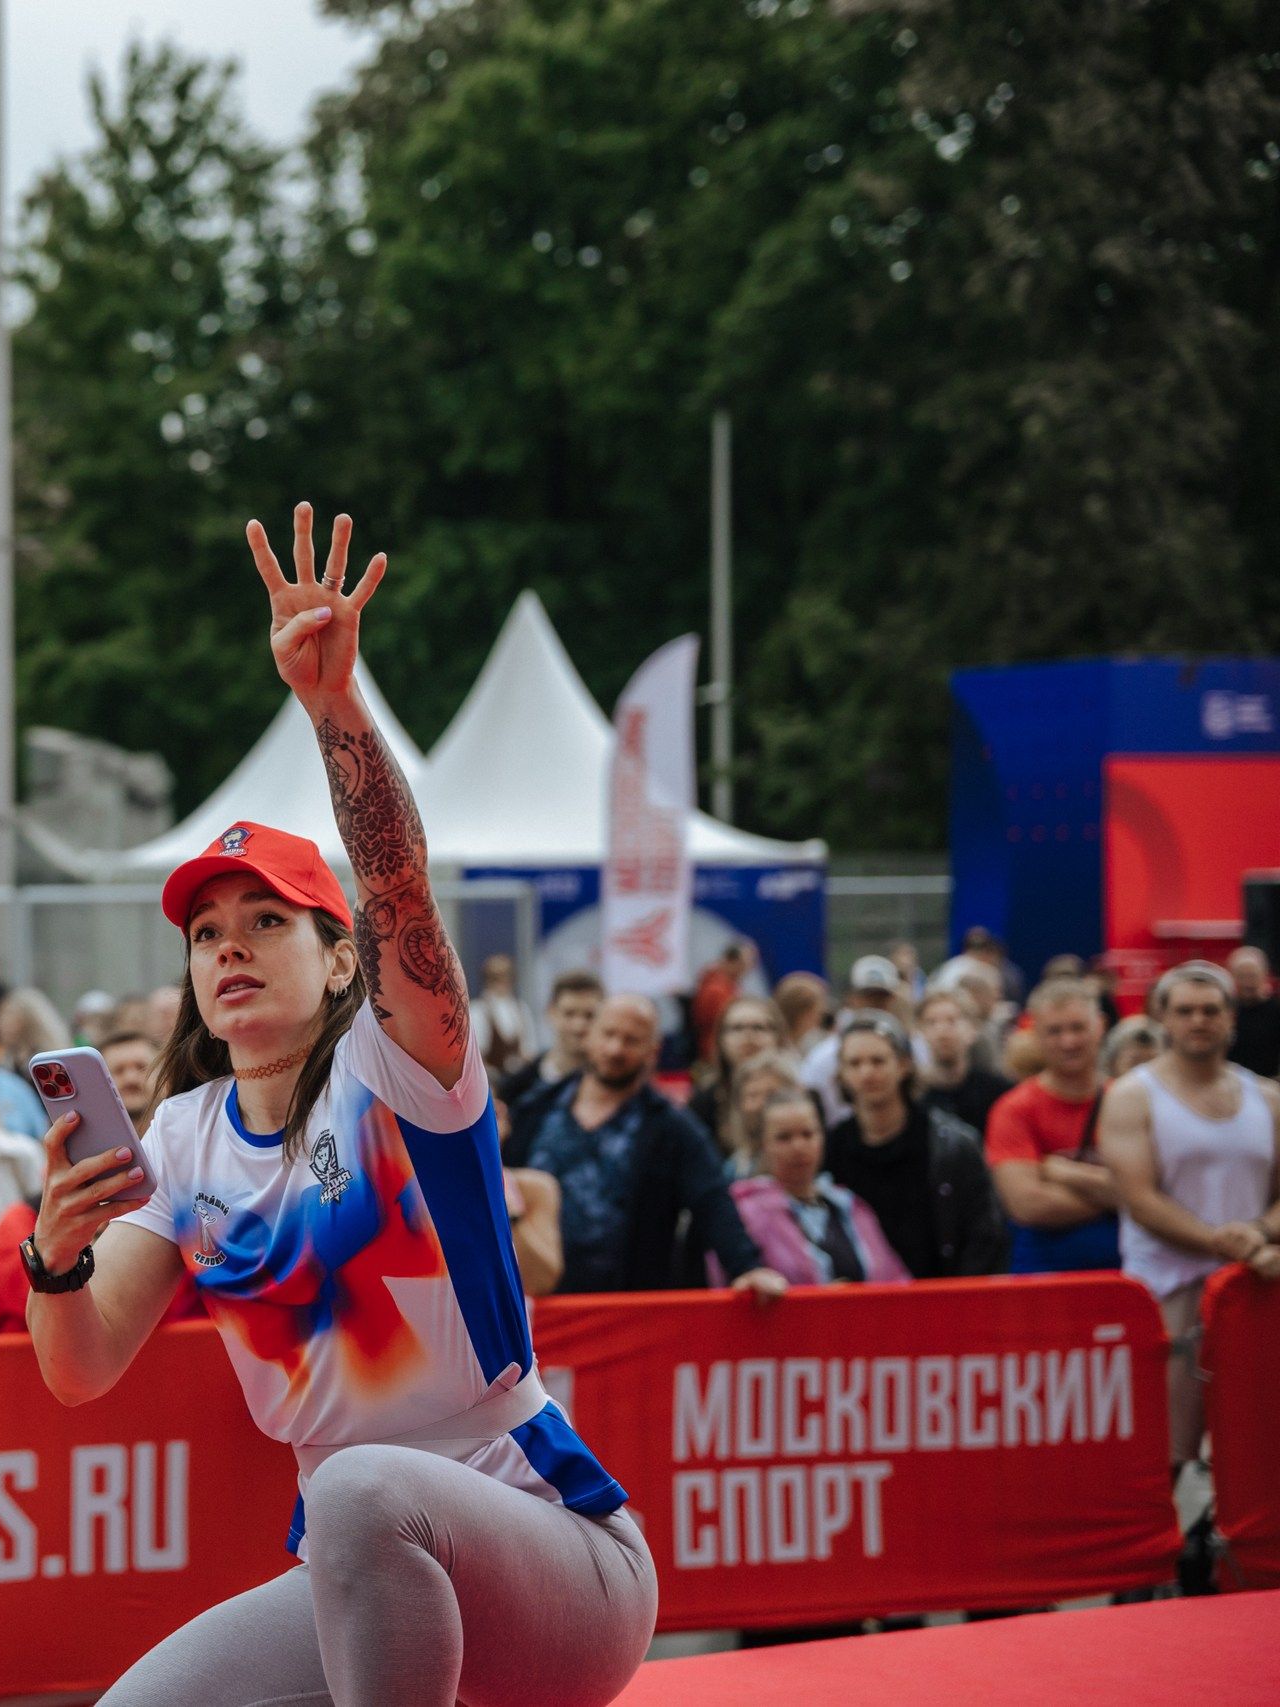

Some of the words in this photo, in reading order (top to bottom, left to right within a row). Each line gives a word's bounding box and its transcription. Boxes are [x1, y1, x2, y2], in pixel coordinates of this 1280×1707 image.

[192, 1191, 231, 1216] НЕЙШИЙ
[673, 1324, 1134, 1463] МОСКОВСКИЙ
[673, 1461, 893, 1569] СПОРТ
